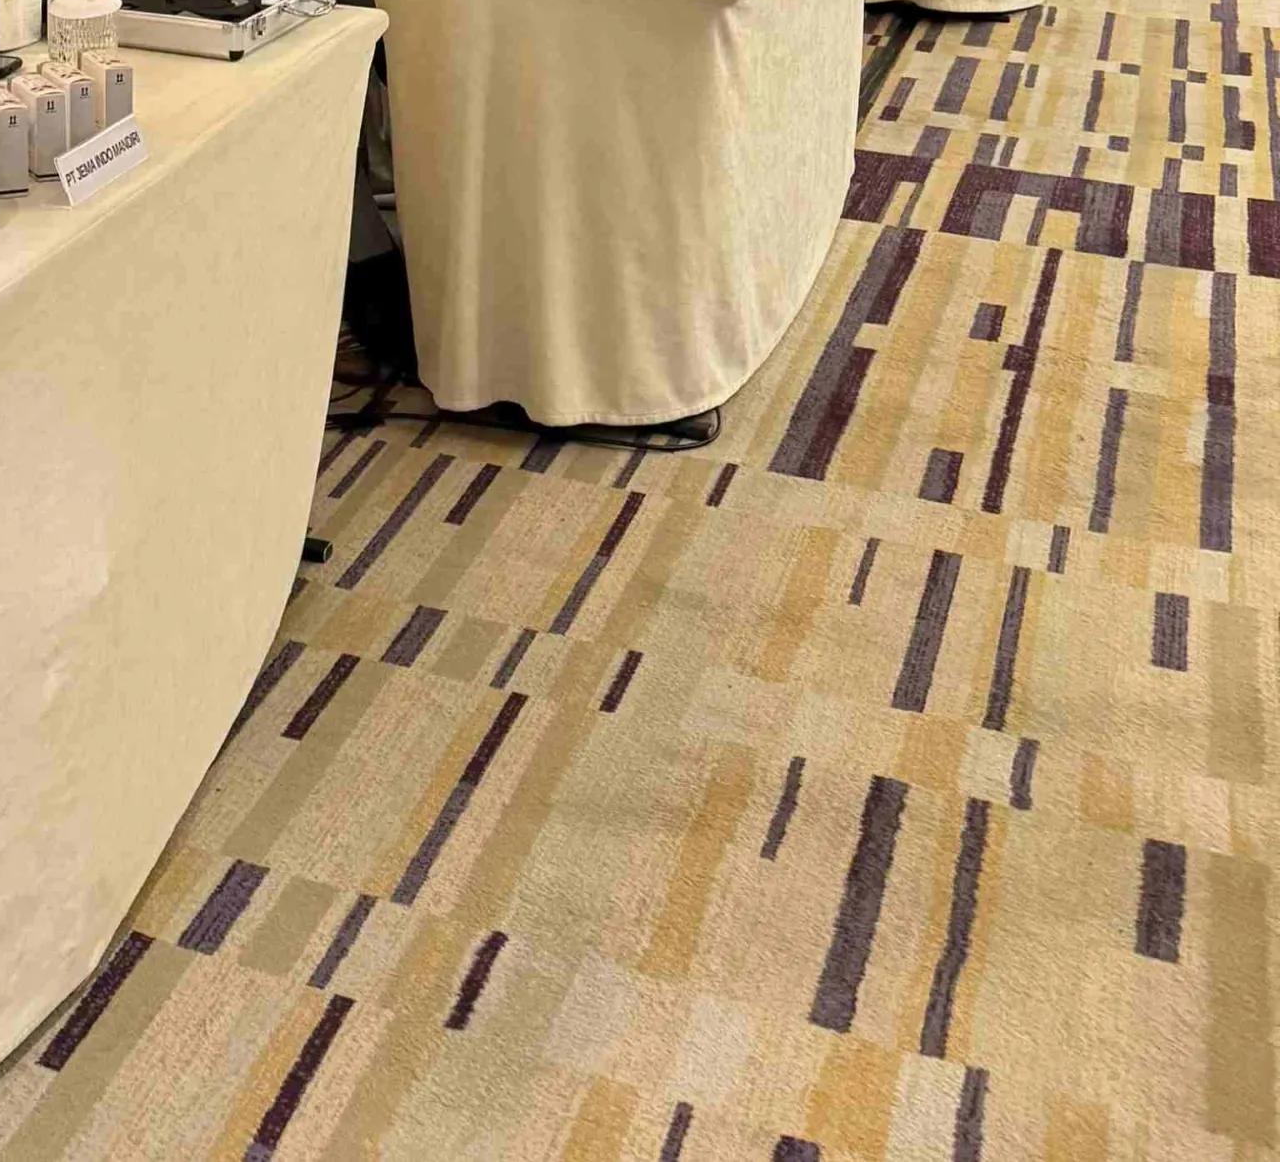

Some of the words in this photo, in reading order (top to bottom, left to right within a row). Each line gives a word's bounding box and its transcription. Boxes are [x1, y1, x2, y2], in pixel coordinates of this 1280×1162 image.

[65, 170, 76, 187] PT
[76, 159, 97, 180] JEMA
[94, 148, 114, 169] INDO
[112, 130, 141, 157] MANDIRI
